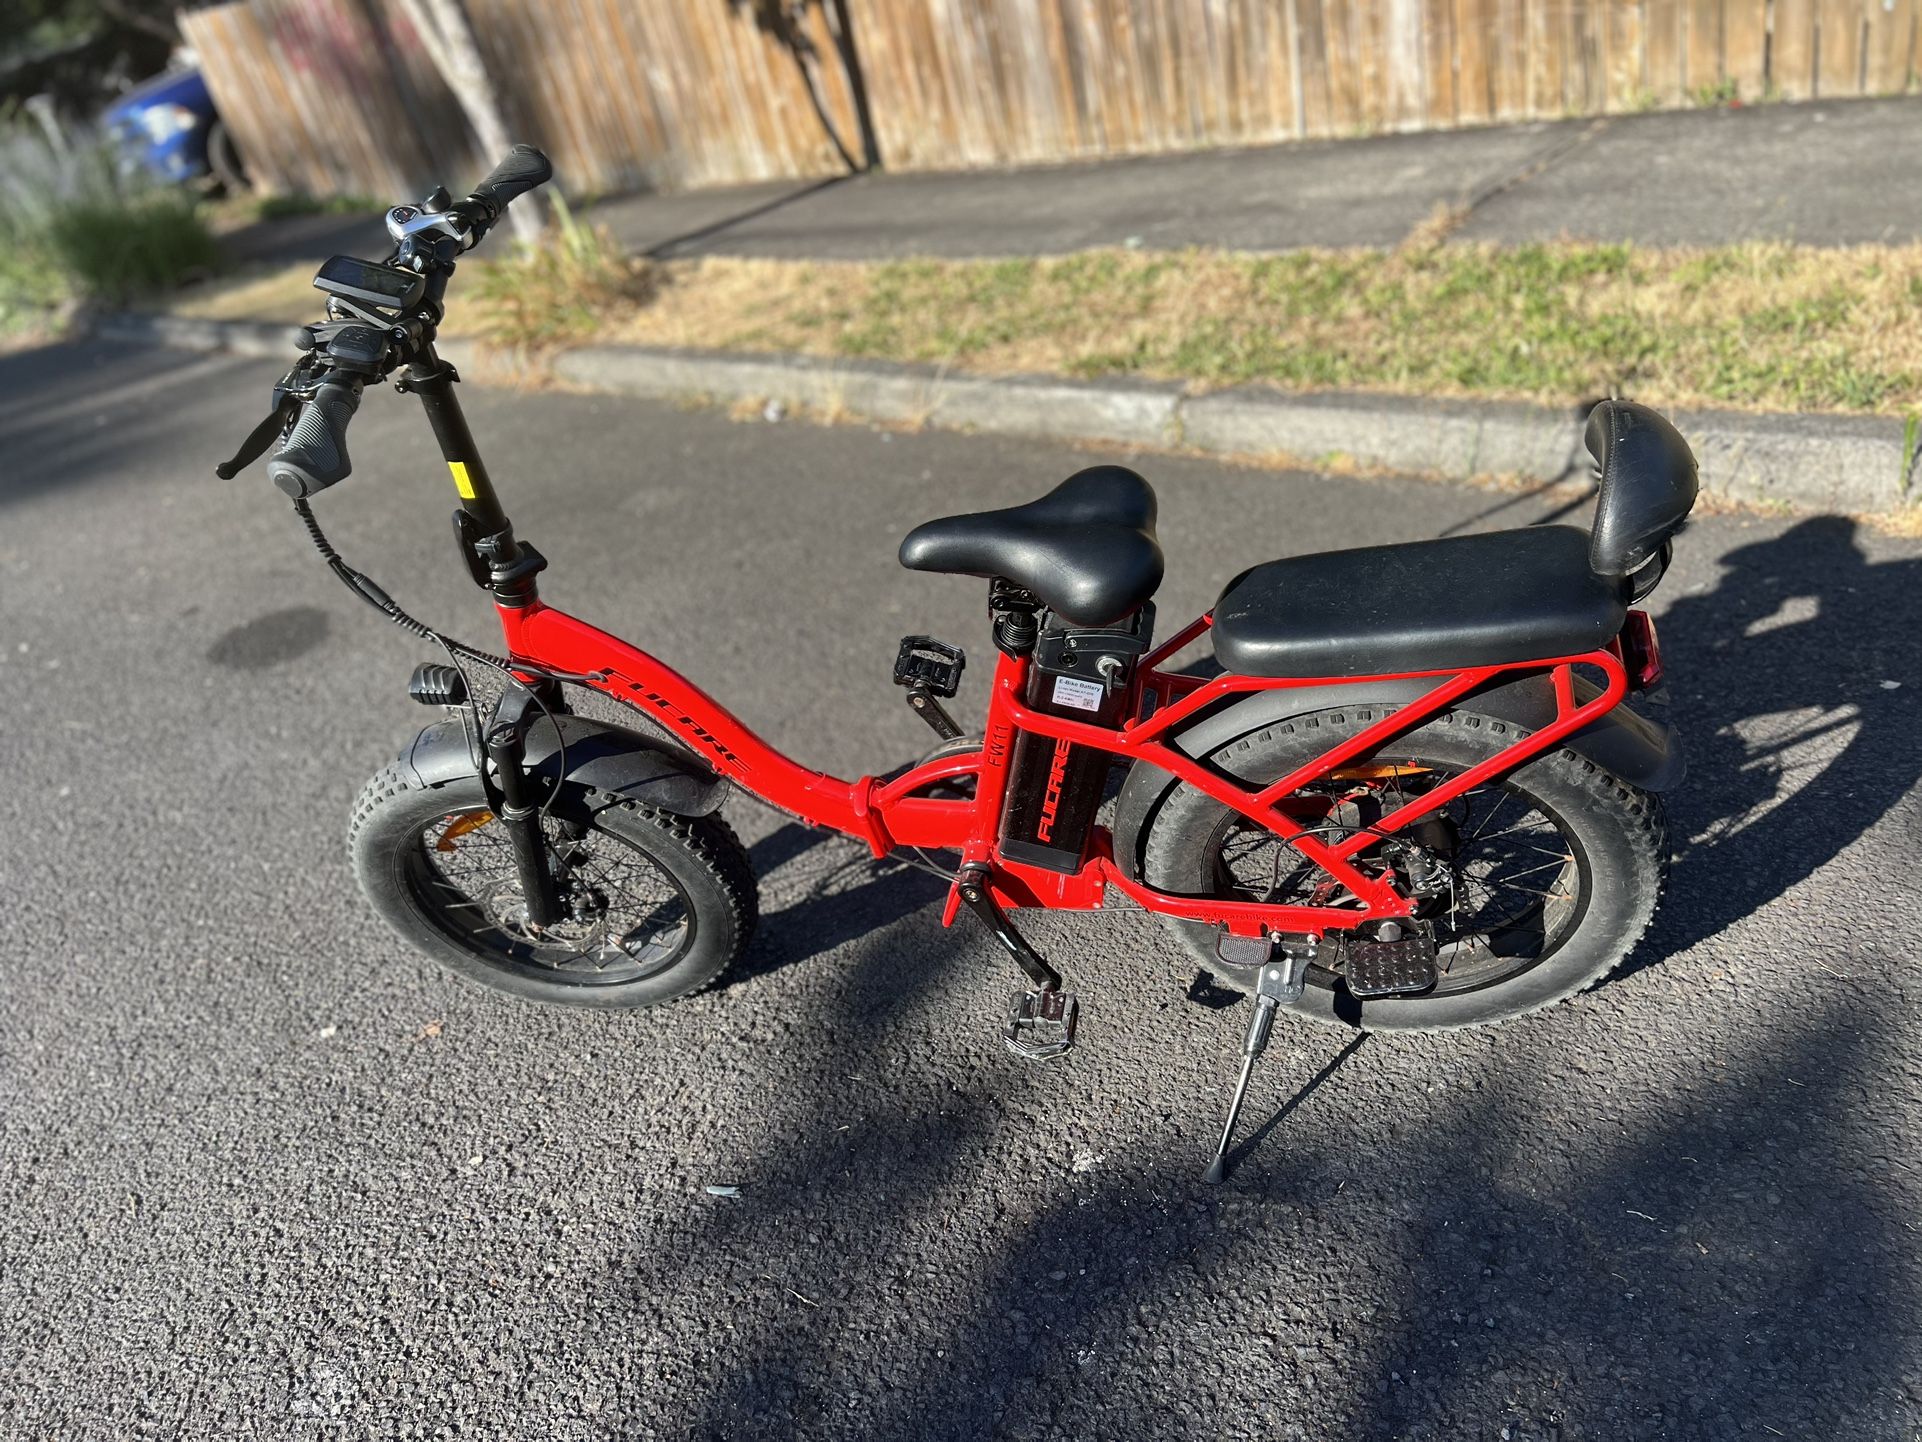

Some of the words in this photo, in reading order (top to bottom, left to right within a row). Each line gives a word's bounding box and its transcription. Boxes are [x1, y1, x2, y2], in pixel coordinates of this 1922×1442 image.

[599, 667, 752, 773] FUCARE
[1058, 678, 1079, 687] E-Bike
[1079, 682, 1101, 693] Battery
[987, 725, 1009, 767] FW11
[1037, 737, 1071, 843] FUCARE
